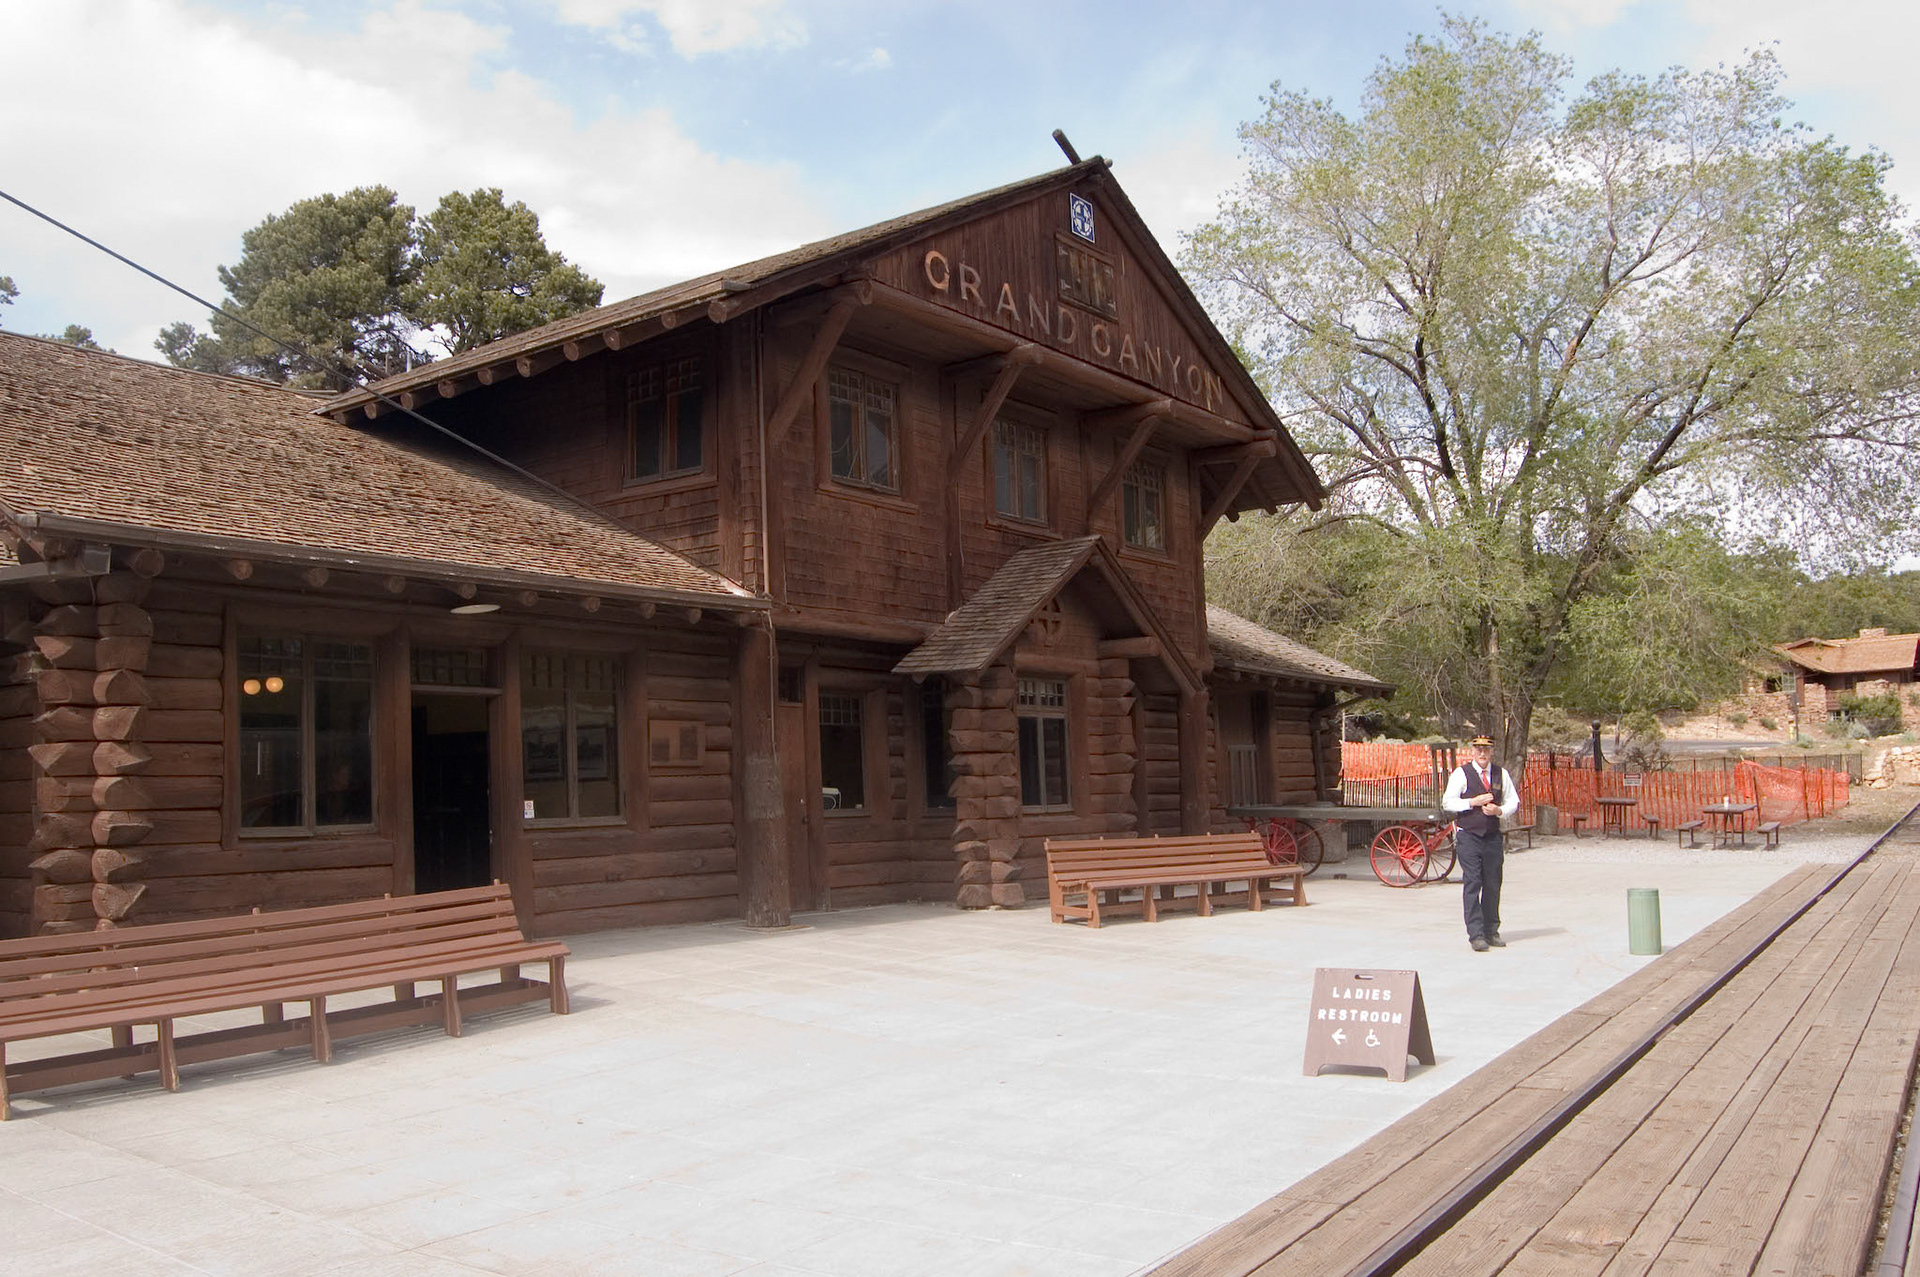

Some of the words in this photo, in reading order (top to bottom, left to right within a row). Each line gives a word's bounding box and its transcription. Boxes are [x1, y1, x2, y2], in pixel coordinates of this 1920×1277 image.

[924, 250, 1077, 344] GRAND
[1091, 324, 1223, 411] CANYON
[1332, 986, 1392, 1001] LADIES
[1317, 1008, 1402, 1024] RESTROOM
